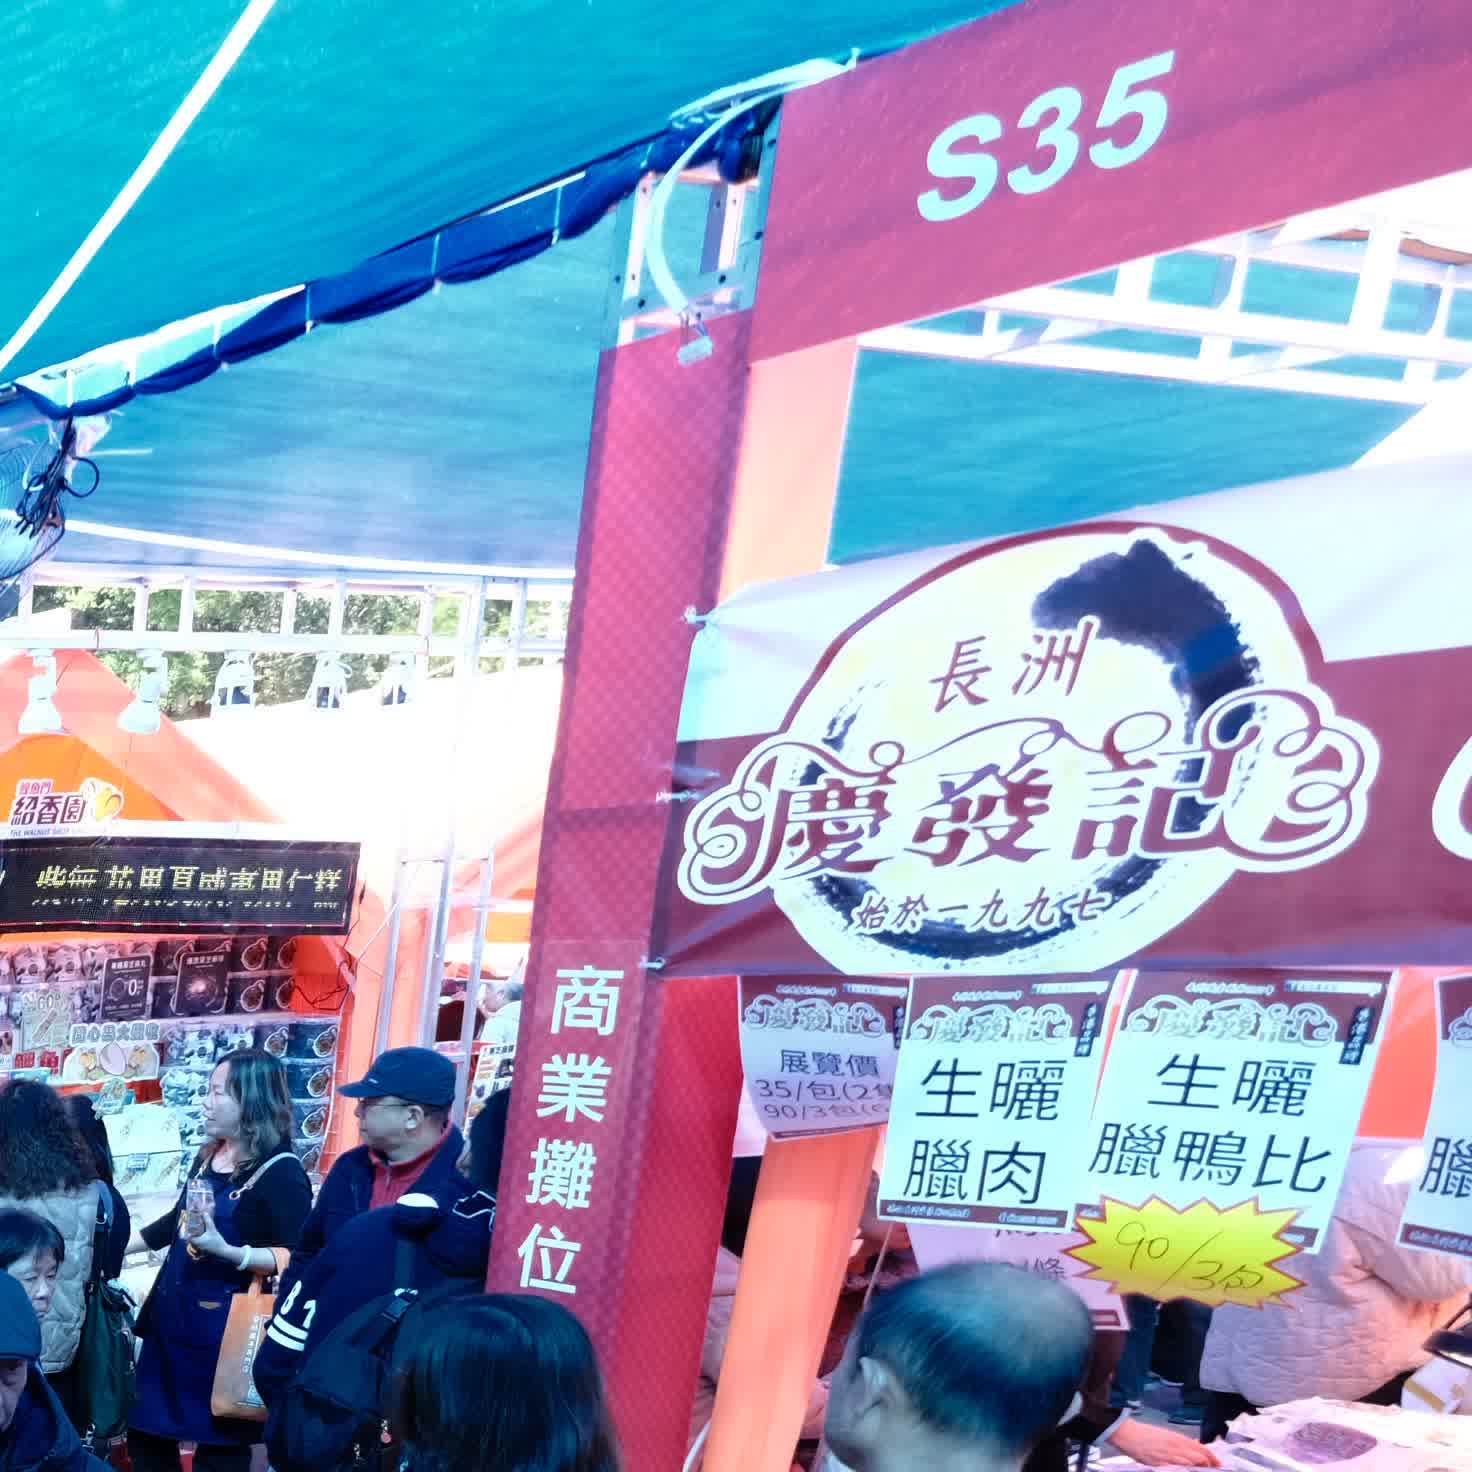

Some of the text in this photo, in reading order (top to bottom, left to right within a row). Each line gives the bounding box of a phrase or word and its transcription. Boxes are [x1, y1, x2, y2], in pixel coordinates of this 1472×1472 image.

[917, 50, 1174, 221] S35
[930, 617, 1100, 713] 長洲
[11, 795, 85, 826] 紹香園
[696, 715, 1306, 890] 慶發記
[856, 887, 1106, 929] 始於一九九七
[781, 1049, 880, 1078] 展覽價
[916, 1058, 1067, 1121] 生曬
[1148, 1053, 1317, 1118] 生曬
[518, 964, 624, 1296] 商業攤位
[1088, 1123, 1332, 1193] 臘鴨比
[903, 1139, 1046, 1204] 臘肉
